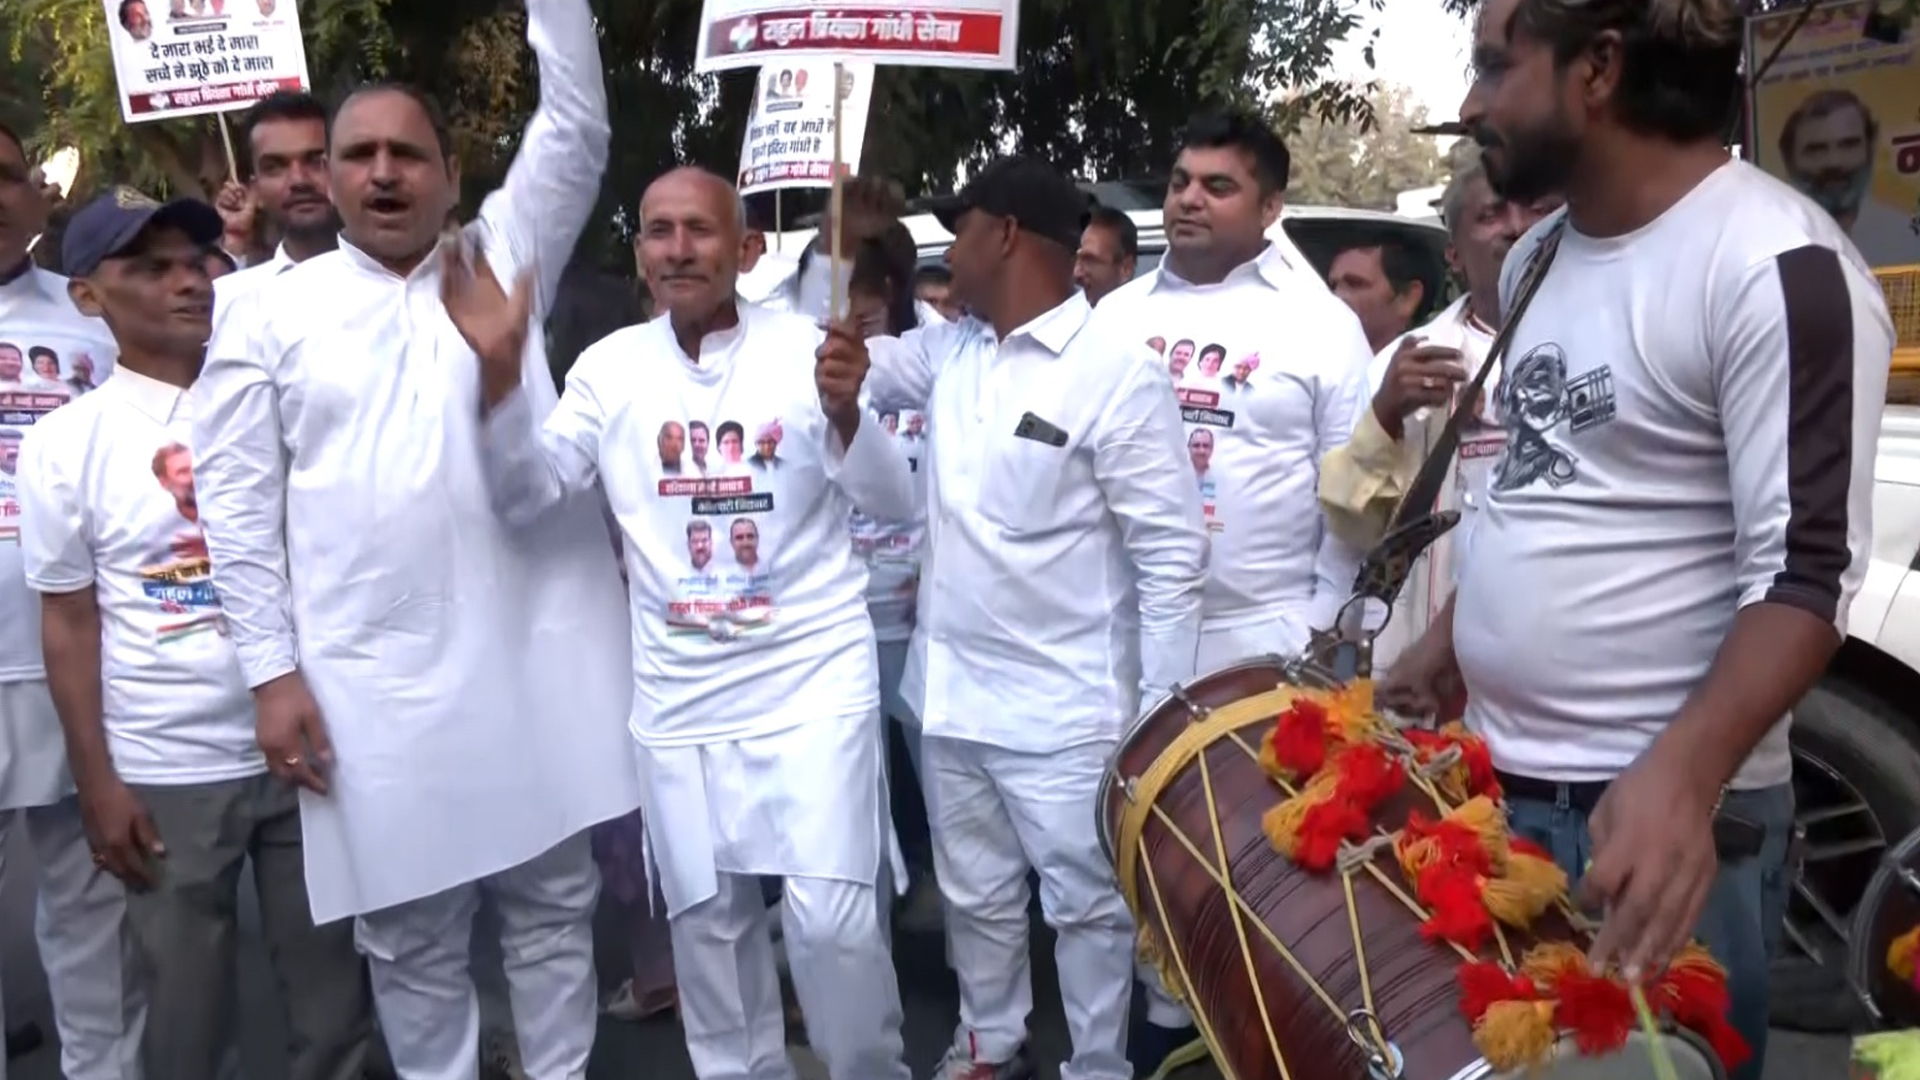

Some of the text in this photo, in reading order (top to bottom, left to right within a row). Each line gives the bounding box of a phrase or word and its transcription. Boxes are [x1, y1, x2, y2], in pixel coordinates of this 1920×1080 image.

[762, 12, 962, 46] राहुल प्रियंका गांधी सेना
[161, 40, 191, 58] मारा
[217, 35, 226, 52] दे
[228, 35, 259, 51] मारा
[174, 63, 186, 79] ने
[212, 57, 229, 75] को
[231, 55, 240, 72] दे
[243, 55, 273, 72] मारा
